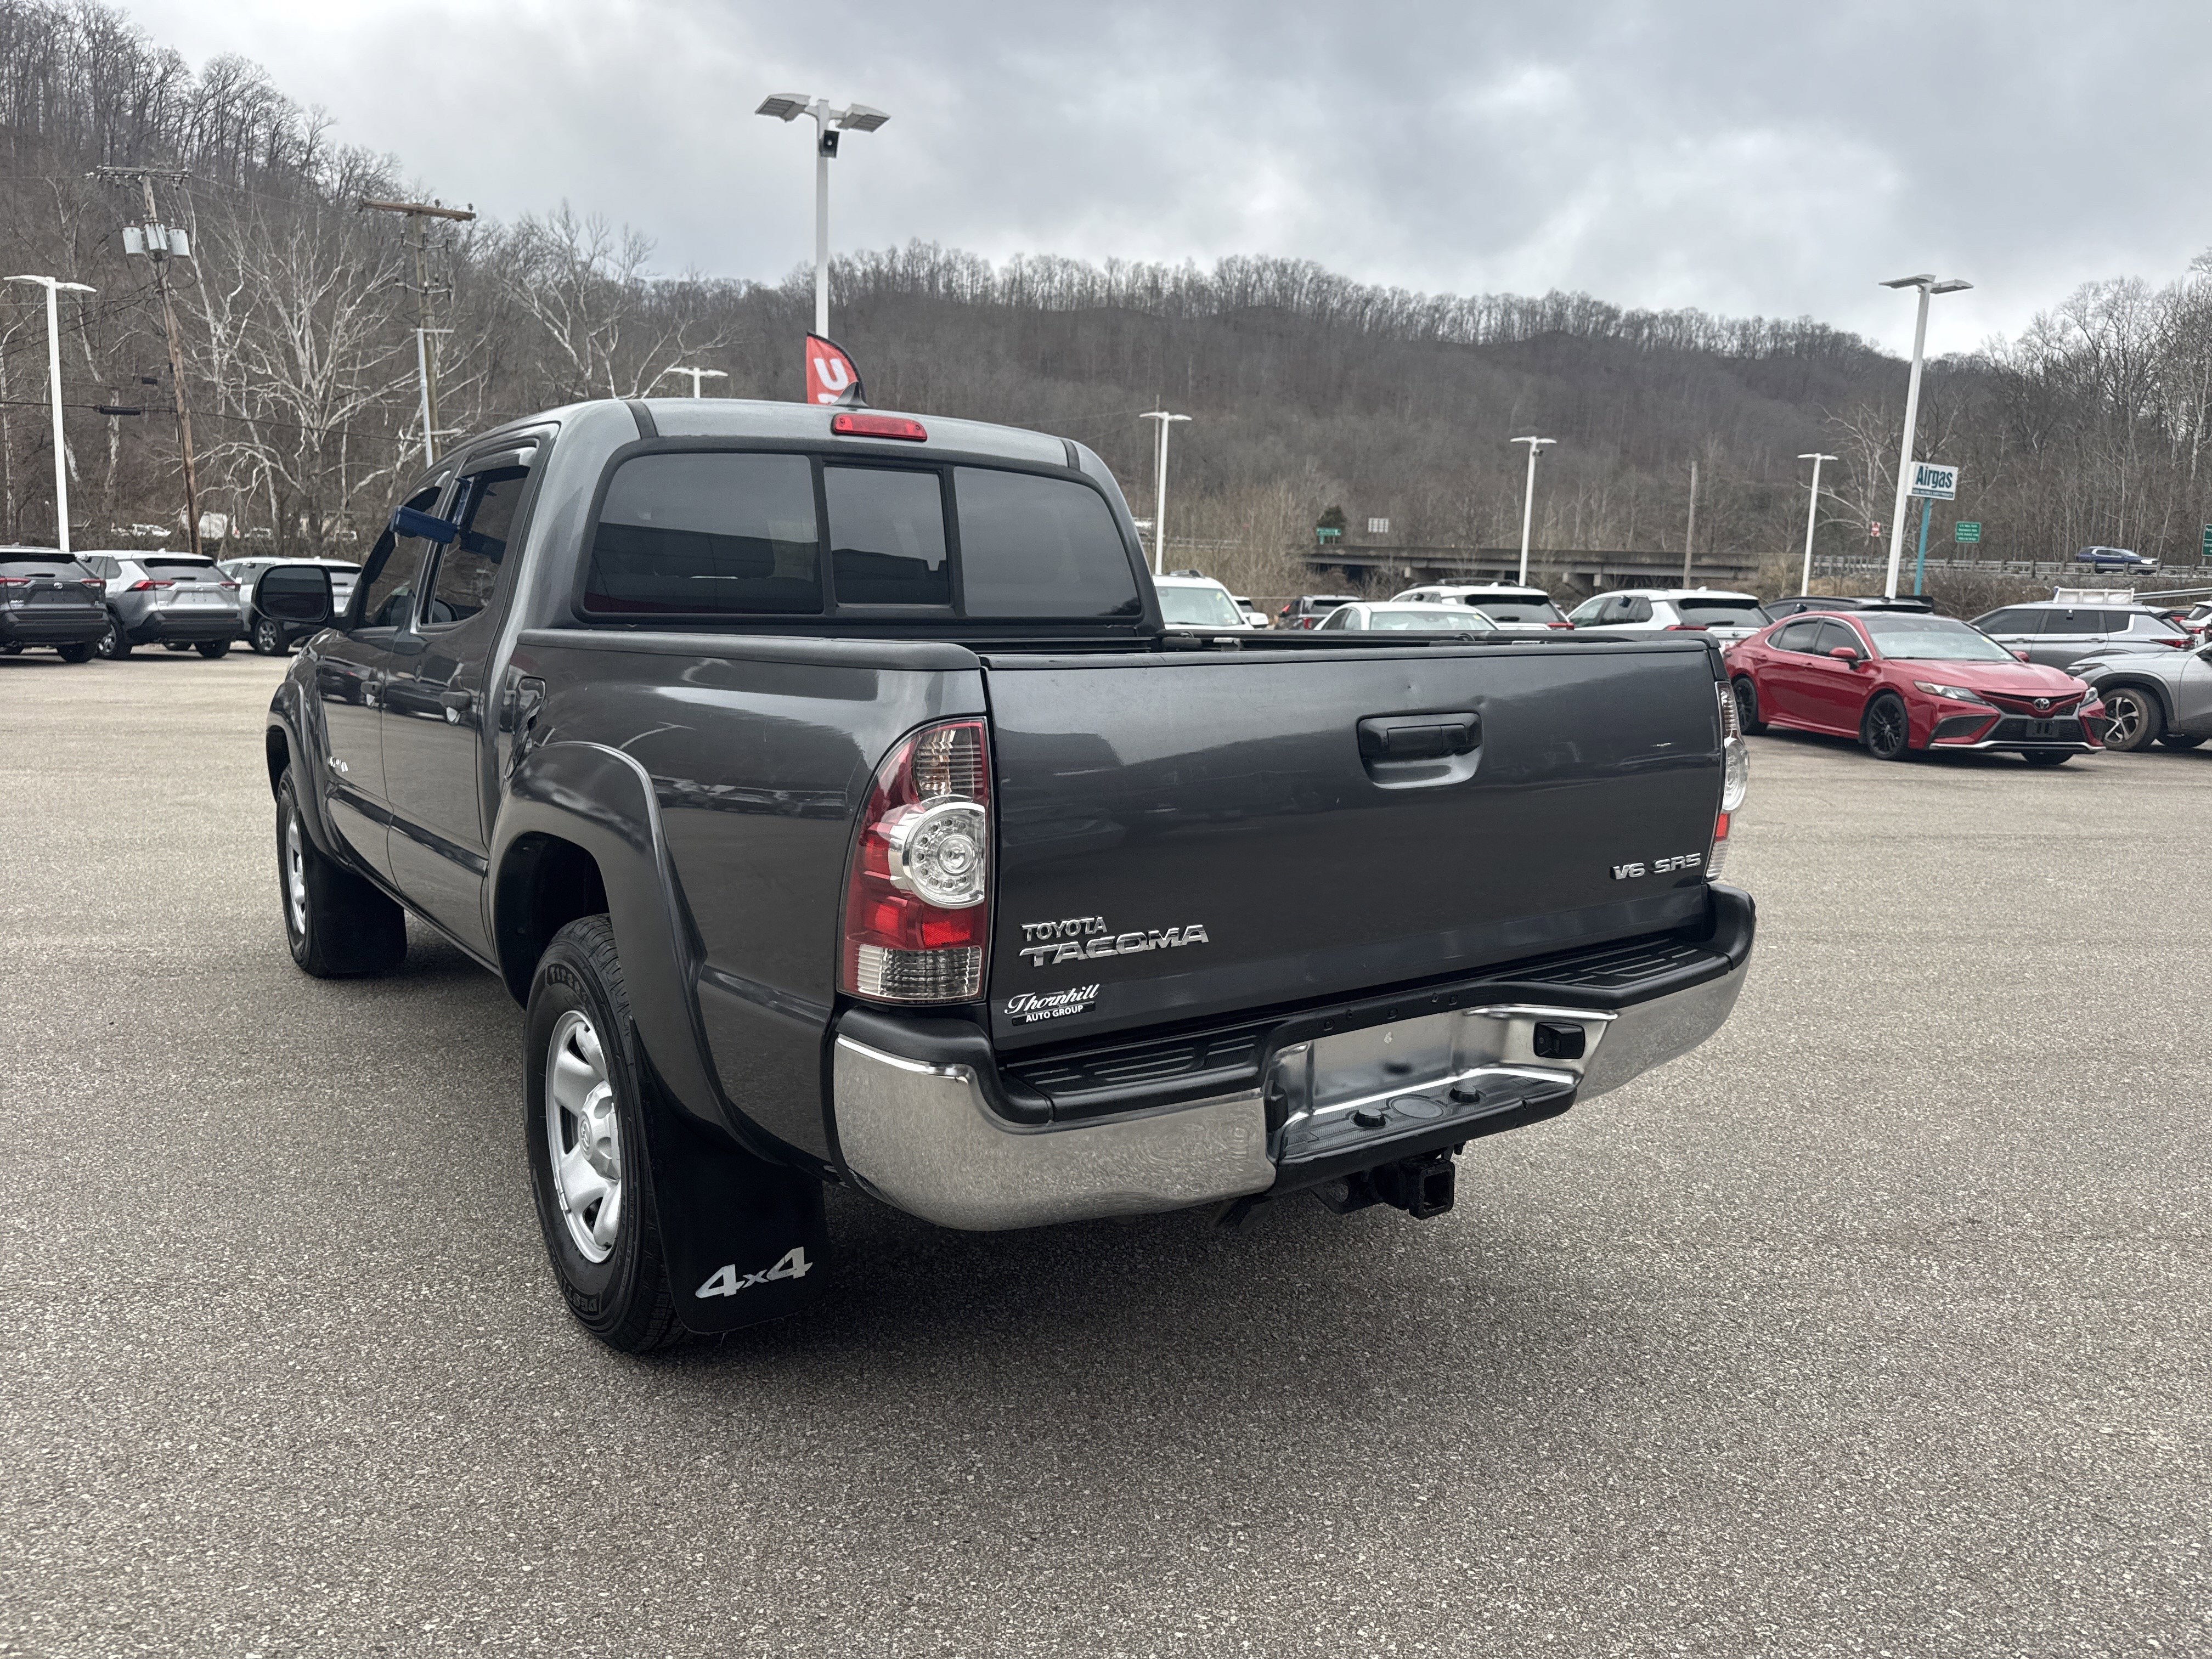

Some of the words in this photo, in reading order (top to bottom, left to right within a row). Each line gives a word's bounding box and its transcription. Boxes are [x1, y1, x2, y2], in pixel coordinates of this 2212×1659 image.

[1915, 465, 1953, 489] Airgas
[1611, 862, 1645, 880] V6
[1652, 853, 1702, 874] SR5
[1021, 916, 1108, 942] TOYOTA
[1019, 924, 1209, 967] TACOMA
[1003, 983, 1101, 1015] Thornhill
[1025, 1009, 1051, 1023] AUTO
[1052, 1005, 1084, 1019] GROUP
[695, 1246, 813, 1299] 4x4
